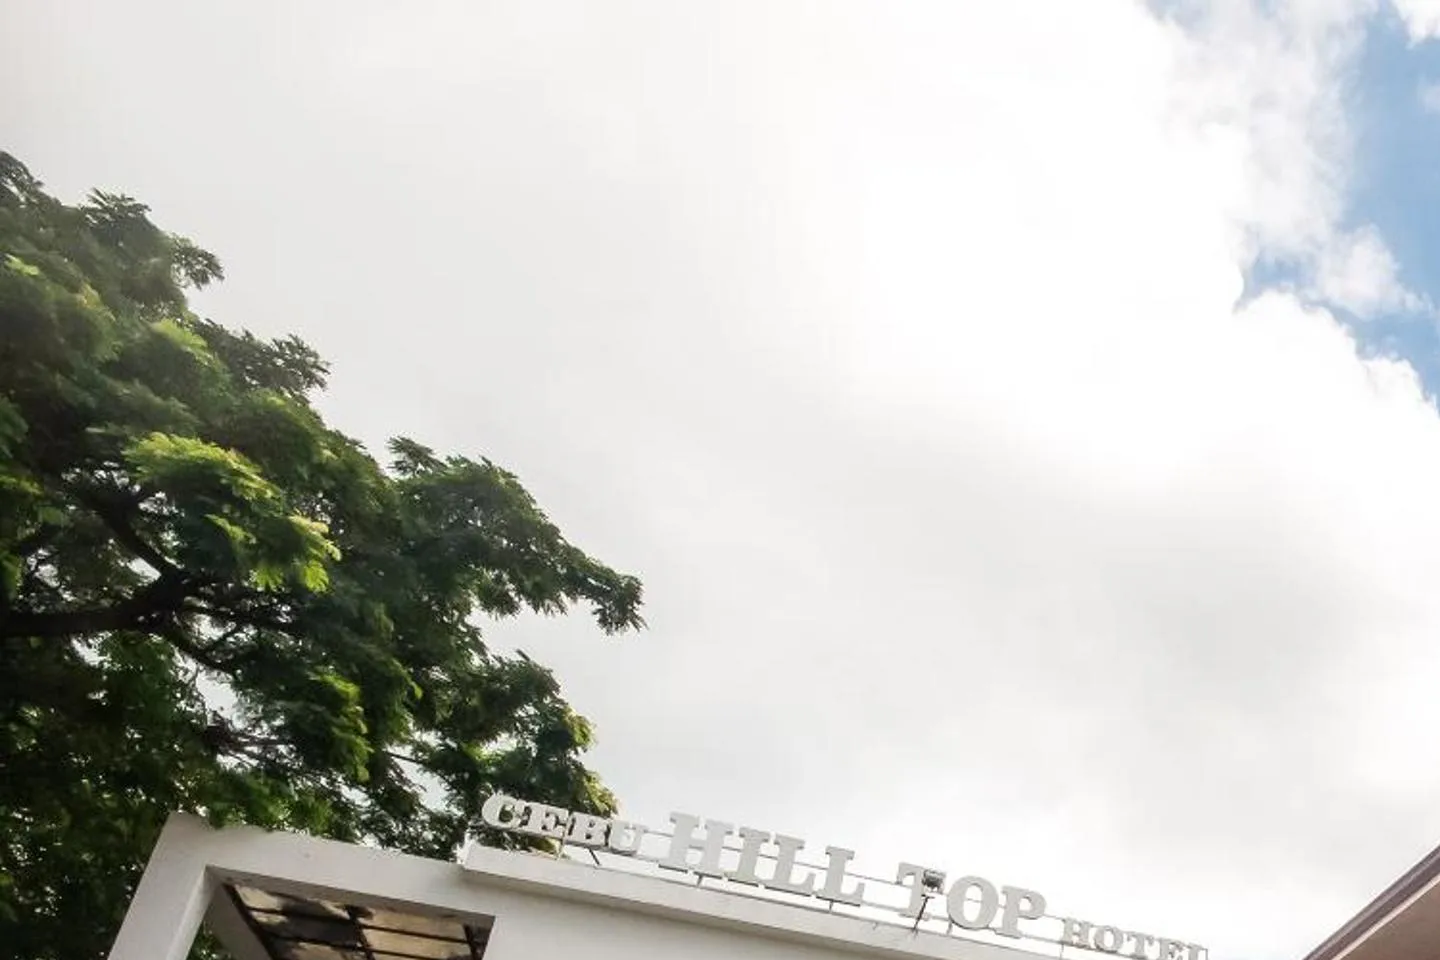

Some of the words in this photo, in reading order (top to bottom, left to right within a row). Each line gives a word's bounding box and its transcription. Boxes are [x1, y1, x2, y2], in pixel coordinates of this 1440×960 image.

[481, 793, 649, 858] CEBU
[658, 811, 864, 907] HILL
[895, 861, 1047, 939] TOP
